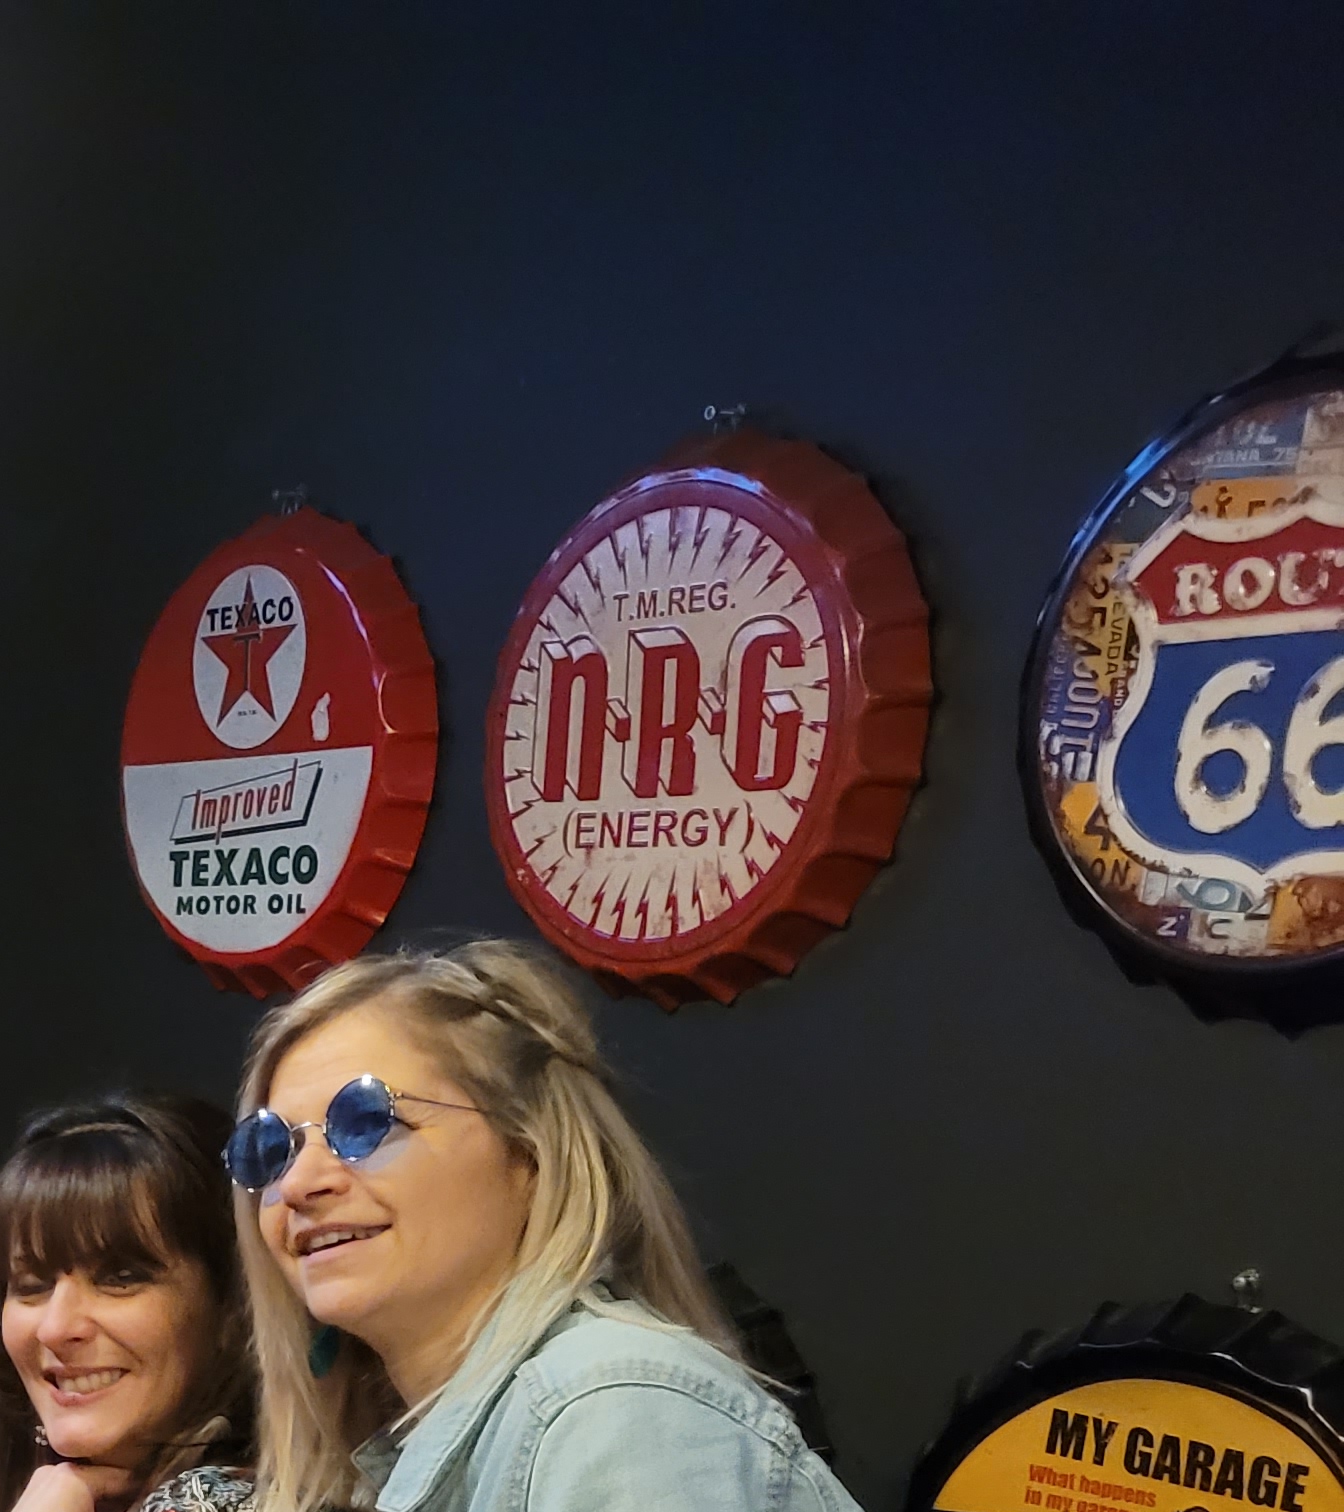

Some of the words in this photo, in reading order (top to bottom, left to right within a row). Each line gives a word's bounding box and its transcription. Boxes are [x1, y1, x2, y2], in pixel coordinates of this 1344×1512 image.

[206, 595, 295, 632] TEXACO
[1104, 596, 1123, 676] EVADA
[1174, 658, 1344, 835] 66
[191, 758, 298, 845] Improved
[562, 806, 754, 857] (ENERGY)
[169, 844, 319, 887] TEXACO
[176, 894, 257, 915] MOTOR
[267, 893, 306, 914] OIL
[1044, 1408, 1119, 1466] MY
[1024, 1486, 1042, 1506] in
[1028, 1463, 1075, 1491] What
[1079, 1474, 1157, 1508] happens
